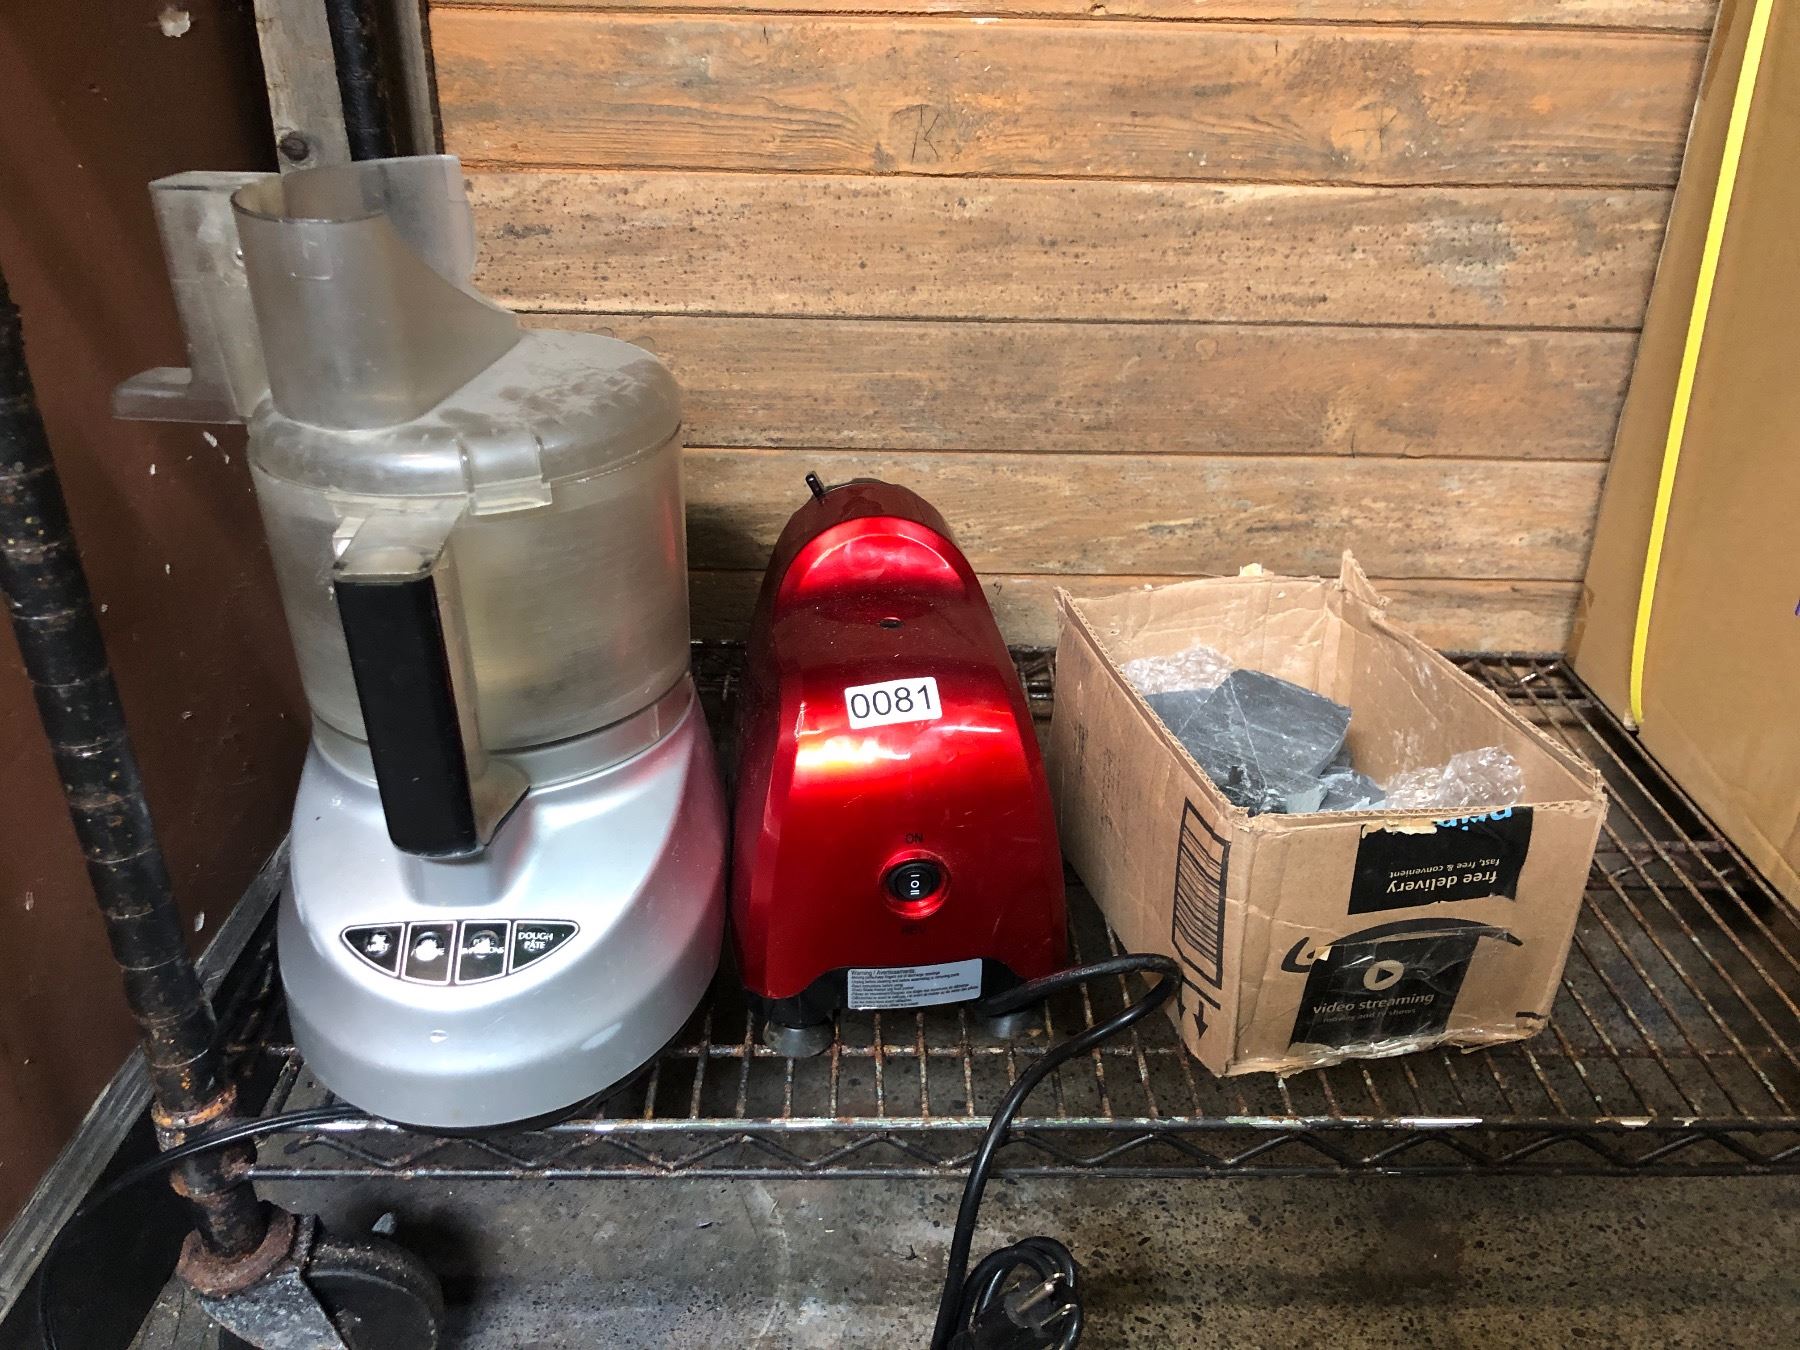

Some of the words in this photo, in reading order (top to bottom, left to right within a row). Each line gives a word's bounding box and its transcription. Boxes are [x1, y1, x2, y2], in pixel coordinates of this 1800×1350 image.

[850, 685, 931, 719] 0081
[905, 833, 924, 844] ON
[1457, 862, 1476, 871] free
[1479, 858, 1500, 866] fast,
[1389, 865, 1444, 879] convenient
[1446, 864, 1455, 872] &
[1462, 870, 1497, 884] free
[1386, 875, 1458, 894] delivery
[518, 931, 553, 941] DOUGH
[524, 939, 546, 950] PÂTE
[1313, 1002, 1355, 1014] video
[1358, 993, 1435, 1011] streaming
